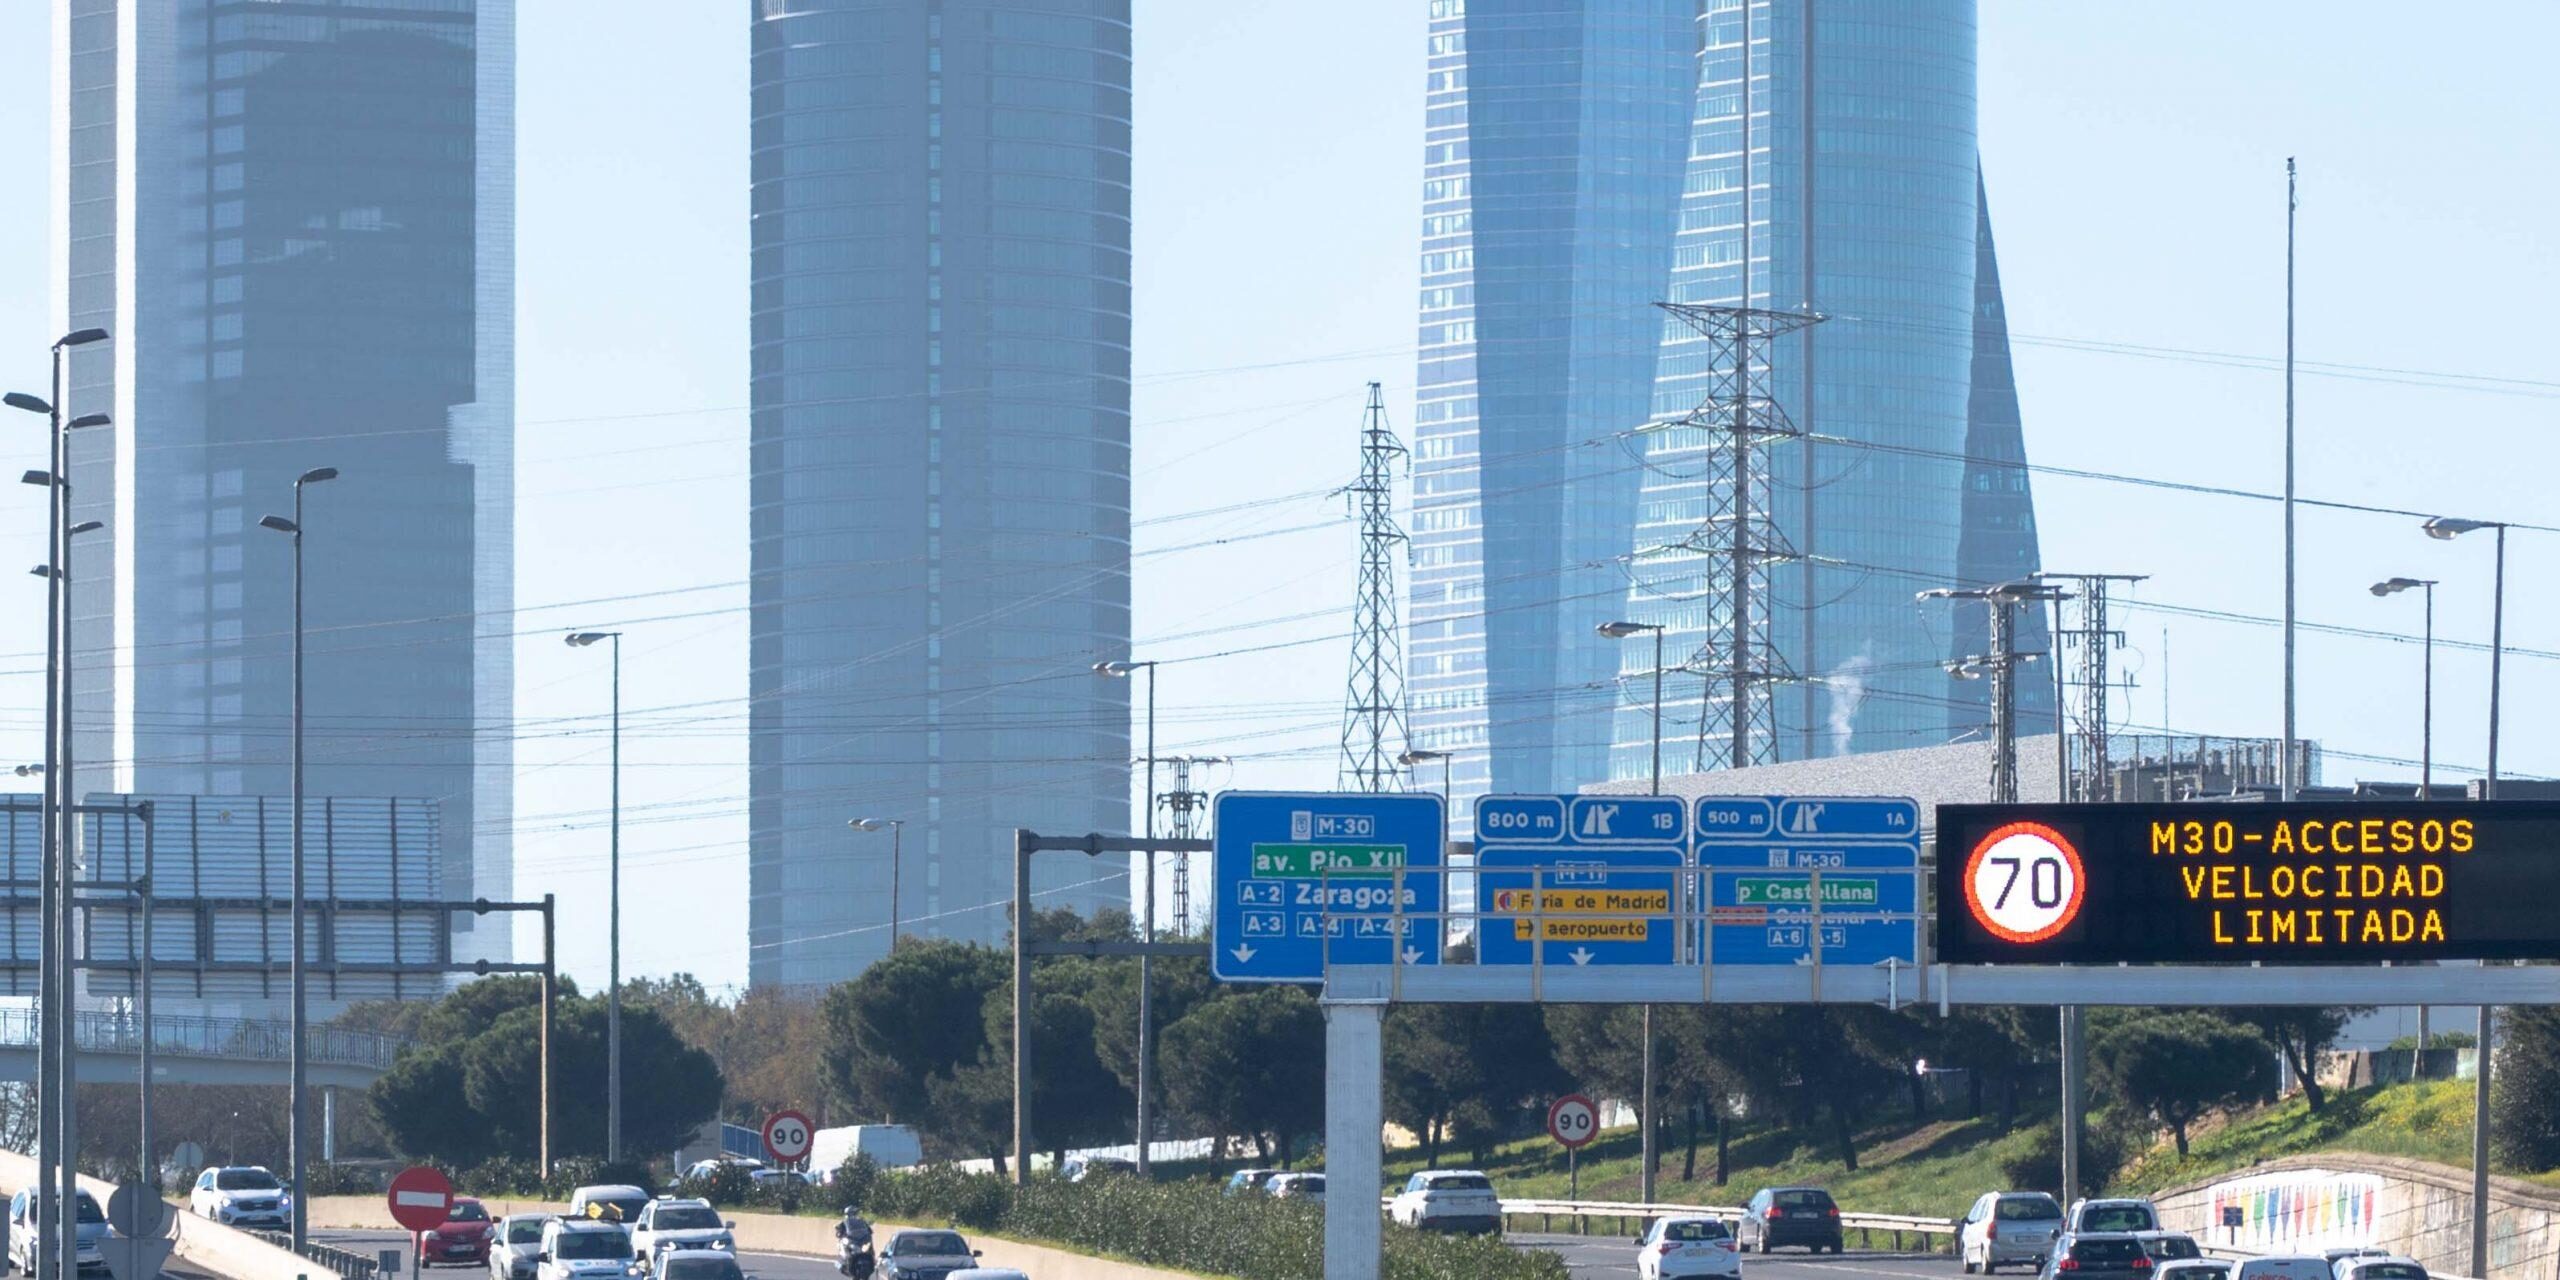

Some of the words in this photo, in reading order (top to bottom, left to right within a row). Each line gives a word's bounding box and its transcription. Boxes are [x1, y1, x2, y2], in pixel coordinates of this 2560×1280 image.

[1318, 818, 1370, 834] M-30
[1488, 812, 1529, 827] 800
[1537, 815, 1554, 828] m
[1652, 814, 1674, 829] 1B
[1708, 811, 1740, 824] 500
[1750, 813, 1764, 825] m
[1886, 813, 1906, 826] 1A
[2151, 819, 2475, 855] M30-ACCESOS
[1256, 854, 1295, 871] av.
[1799, 854, 1842, 868] M-30
[1989, 857, 2063, 910] 70
[2182, 864, 2446, 899] VELOCIDAD
[1242, 885, 1280, 901] A-2
[1521, 895, 1563, 909] Fria
[1574, 894, 1596, 909] de
[1606, 895, 1667, 910] Madrid
[1247, 916, 1281, 931] A-3
[1303, 917, 1339, 932] A-4
[1360, 918, 1410, 933] A-42
[1548, 922, 1646, 938] aeropuerto
[2213, 909, 2446, 944] LIMITADA
[1772, 931, 1800, 944] A-6
[1560, 1113, 1589, 1130] 90
[774, 1128, 803, 1145] 90
